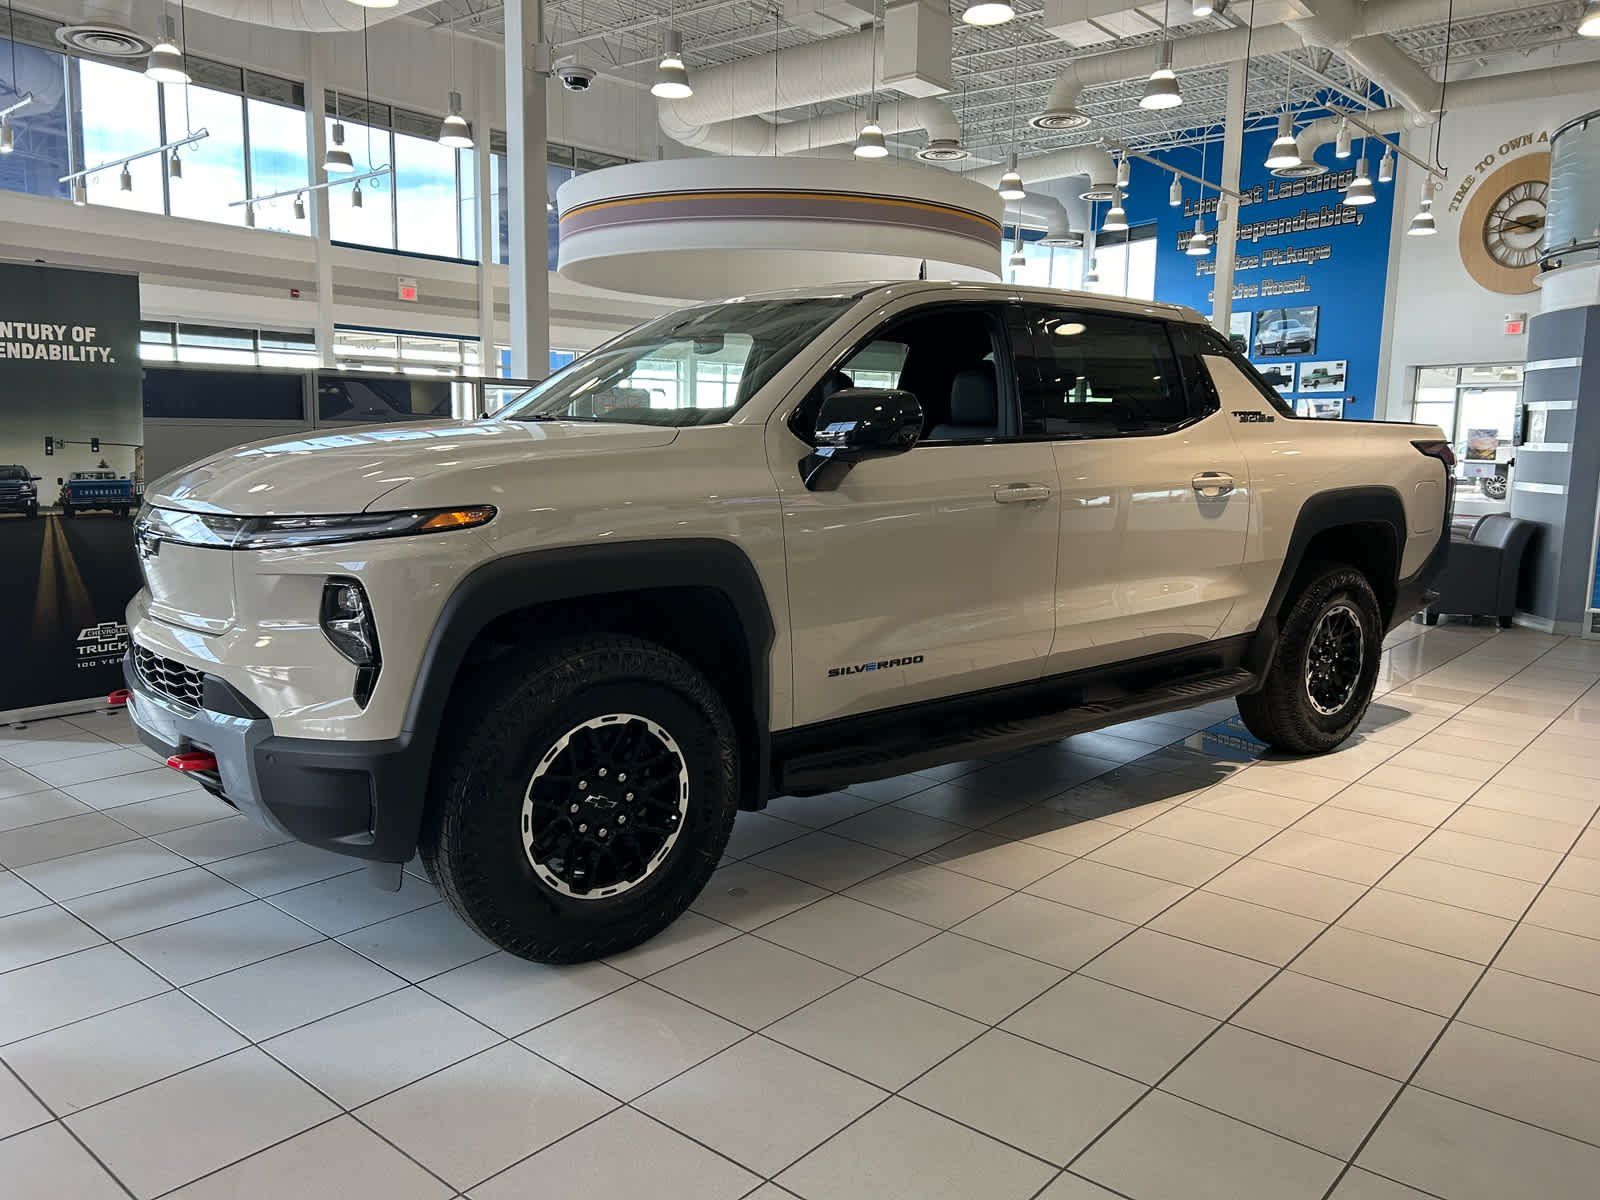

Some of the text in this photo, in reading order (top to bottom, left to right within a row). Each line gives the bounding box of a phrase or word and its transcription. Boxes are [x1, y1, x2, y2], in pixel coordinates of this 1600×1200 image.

[1448, 131, 1549, 214] TIME TO OWN A
[1183, 185, 1263, 218] Lonst
[1236, 203, 1364, 242] ependable,
[1262, 244, 1331, 267] Pickups
[1261, 275, 1311, 297] Road.
[0, 321, 97, 343] NTURY OF
[828, 655, 924, 677] SILVERADO
